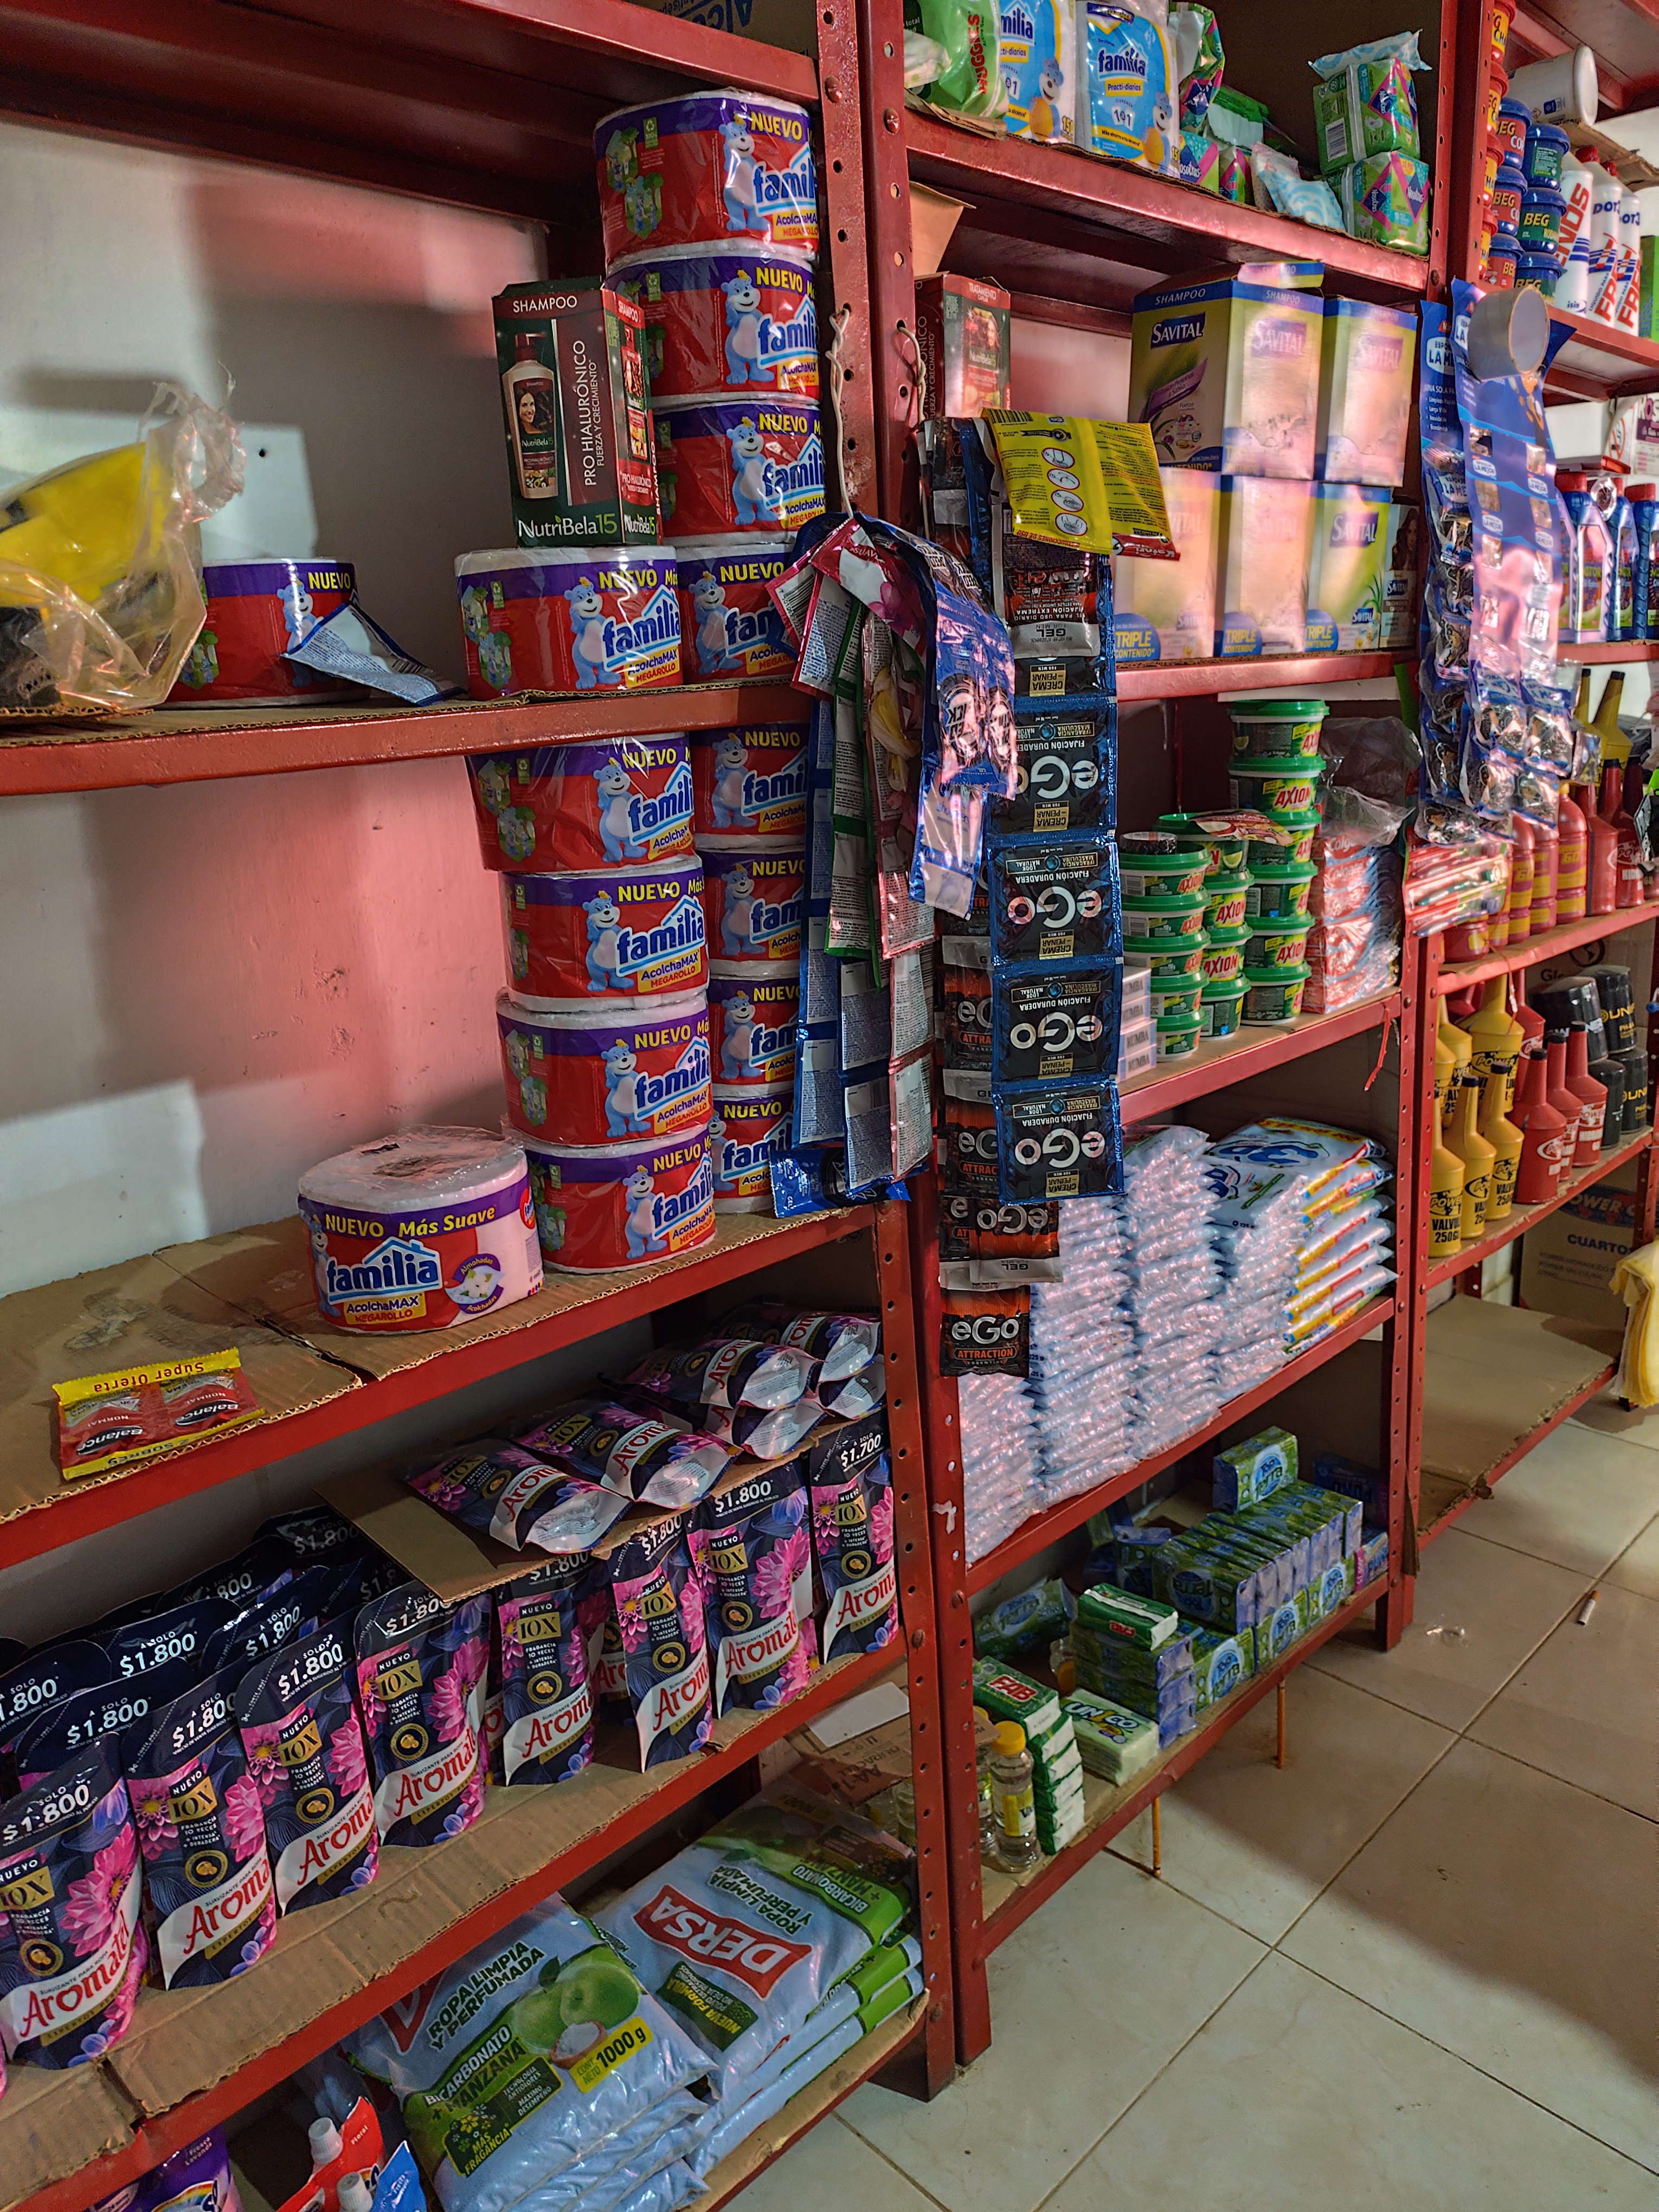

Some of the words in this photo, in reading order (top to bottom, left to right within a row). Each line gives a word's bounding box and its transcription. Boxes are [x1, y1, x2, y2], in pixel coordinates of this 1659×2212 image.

[1001, 8, 1033, 40] milia
[968, 14, 988, 94] HUGGIES
[1098, 48, 1146, 75] familia
[751, 112, 802, 140] NUEVO
[1180, 163, 1200, 177] osotras
[1372, 189, 1381, 213] Nosotras
[1407, 185, 1424, 202] Nosotras
[1493, 192, 1515, 207] BEG
[1523, 213, 1550, 226] BEG
[756, 267, 802, 293] NUEVO
[968, 282, 996, 300] TRATAMIENTO
[513, 295, 577, 313] SHAMPOO
[1155, 288, 1206, 305] SHAMPOO
[1266, 289, 1300, 305] SHAMPOO
[1589, 286, 1603, 311] LIQUIDO
[618, 300, 639, 323] SHAMPOO
[1152, 320, 1203, 344] SAVITAL
[573, 340, 593, 453] HIALURÓNICO
[590, 365, 600, 425] CRECIMIENTO
[759, 413, 808, 433] NUEVO
[584, 456, 596, 485] PRO
[518, 513, 618, 538] NutriBela15
[1332, 514, 1375, 542] SAVITAL
[309, 571, 350, 590] NUEVO
[603, 599, 680, 657] familia
[1036, 628, 1066, 637] GEL
[1115, 631, 1152, 648] TRIPLE
[1226, 629, 1257, 644] TRIPLE
[636, 663, 676, 683] MEGAROLLO
[1032, 673, 1057, 681] PEINAR
[1032, 680, 1063, 690] CREMA
[745, 731, 800, 748] NUEVO
[1051, 740, 1084, 751] FIJACIÓN
[1274, 786, 1312, 809] AXION
[1037, 816, 1066, 826] CREMA
[1015, 873, 1053, 884] DURADERA
[1056, 870, 1089, 881] FIJACIÓN
[618, 882, 680, 903] NUEVO
[1007, 886, 1102, 928] eGo
[1215, 899, 1245, 922] AXION
[617, 913, 704, 964] familia
[1042, 944, 1071, 954] CREMA
[1043, 938, 1065, 947] PEINAR
[641, 951, 699, 982] AcolchaMAX
[1204, 953, 1239, 974] AXION
[651, 965, 696, 988] MEGAROLLO
[1019, 999, 1056, 1011] DURADERA
[1058, 996, 1090, 1007] FIJACIÓN
[635, 1024, 691, 1050] NUEVO
[1010, 1012, 1103, 1052] eGo
[1127, 1031, 1148, 1048] RUMBA
[1128, 1054, 1149, 1072] RUMBA
[665, 1103, 708, 1127] MEGAROLLO
[724, 1101, 782, 1119] NUEVO
[1022, 1116, 1059, 1127] DURADERA
[1061, 1112, 1092, 1123] FIJACIÓN
[653, 1143, 700, 1172] NUEVO
[1014, 1128, 1105, 1168] eGo
[1049, 1183, 1077, 1193] CREMA
[1574, 1194, 1623, 1212] OWER
[326, 1214, 384, 1237] NUEVO
[398, 1218, 438, 1238] Más
[443, 1206, 495, 1231] Suave
[977, 1205, 1048, 1233] eGo
[327, 1249, 439, 1292] familia
[460, 1257, 493, 1275] Almohadas
[346, 1295, 419, 1314] AcolchaMAX
[467, 1295, 497, 1313] Acolchadas
[951, 1316, 1019, 1344] eGo
[957, 1348, 1014, 1359] ATTRACTION
[155, 1362, 203, 1380] Súper
[840, 1433, 882, 1468] $1.700
[715, 1480, 771, 1513] $1.800
[245, 1605, 301, 1657] $1.800
[520, 1616, 557, 1638] 10X
[278, 1642, 344, 1696] $1.800
[10, 1679, 36, 1695] SOLO
[380, 1669, 420, 1699] 10X
[991, 1676, 1037, 1701] FAB
[101, 1697, 128, 1712] SOLO
[200, 1693, 221, 1711] SOLO
[388, 1692, 419, 1709] FRAGANCIA
[67, 1697, 149, 1744] $1.800
[282, 1731, 319, 1763] 10X
[291, 1756, 321, 1776] FRAGANCIA
[38, 1786, 66, 1806] SOLO
[171, 1789, 215, 1819] 10X
[3, 1785, 89, 1841] $1.800
[181, 1816, 217, 1831] FRAGANCIA
[196, 1824, 217, 1834] VECES
[708, 1875, 759, 1909] LIMPIA
[713, 1864, 802, 1920] PERFUMADA
[791, 1864, 868, 1914] BICARBONATO
[757, 1905, 801, 1935] ROPA
[650, 1895, 792, 1974] DERSA
[20, 1911, 130, 2037] Aromatel
[428, 1987, 472, 2039] ROPA
[469, 1940, 530, 1988] LIMPIA
[446, 1947, 544, 2038] PERFUMADA
[666, 1978, 705, 2014] FÓRMULA
[704, 2010, 743, 2034] NUEVA
[596, 2034, 635, 2069] 1000
[423, 2026, 511, 2105] BICARBONATO
[445, 2036, 527, 2113] MANZANA
[351, 2125, 369, 2145] Floral
[464, 2129, 511, 2175] FRAGANCIA
